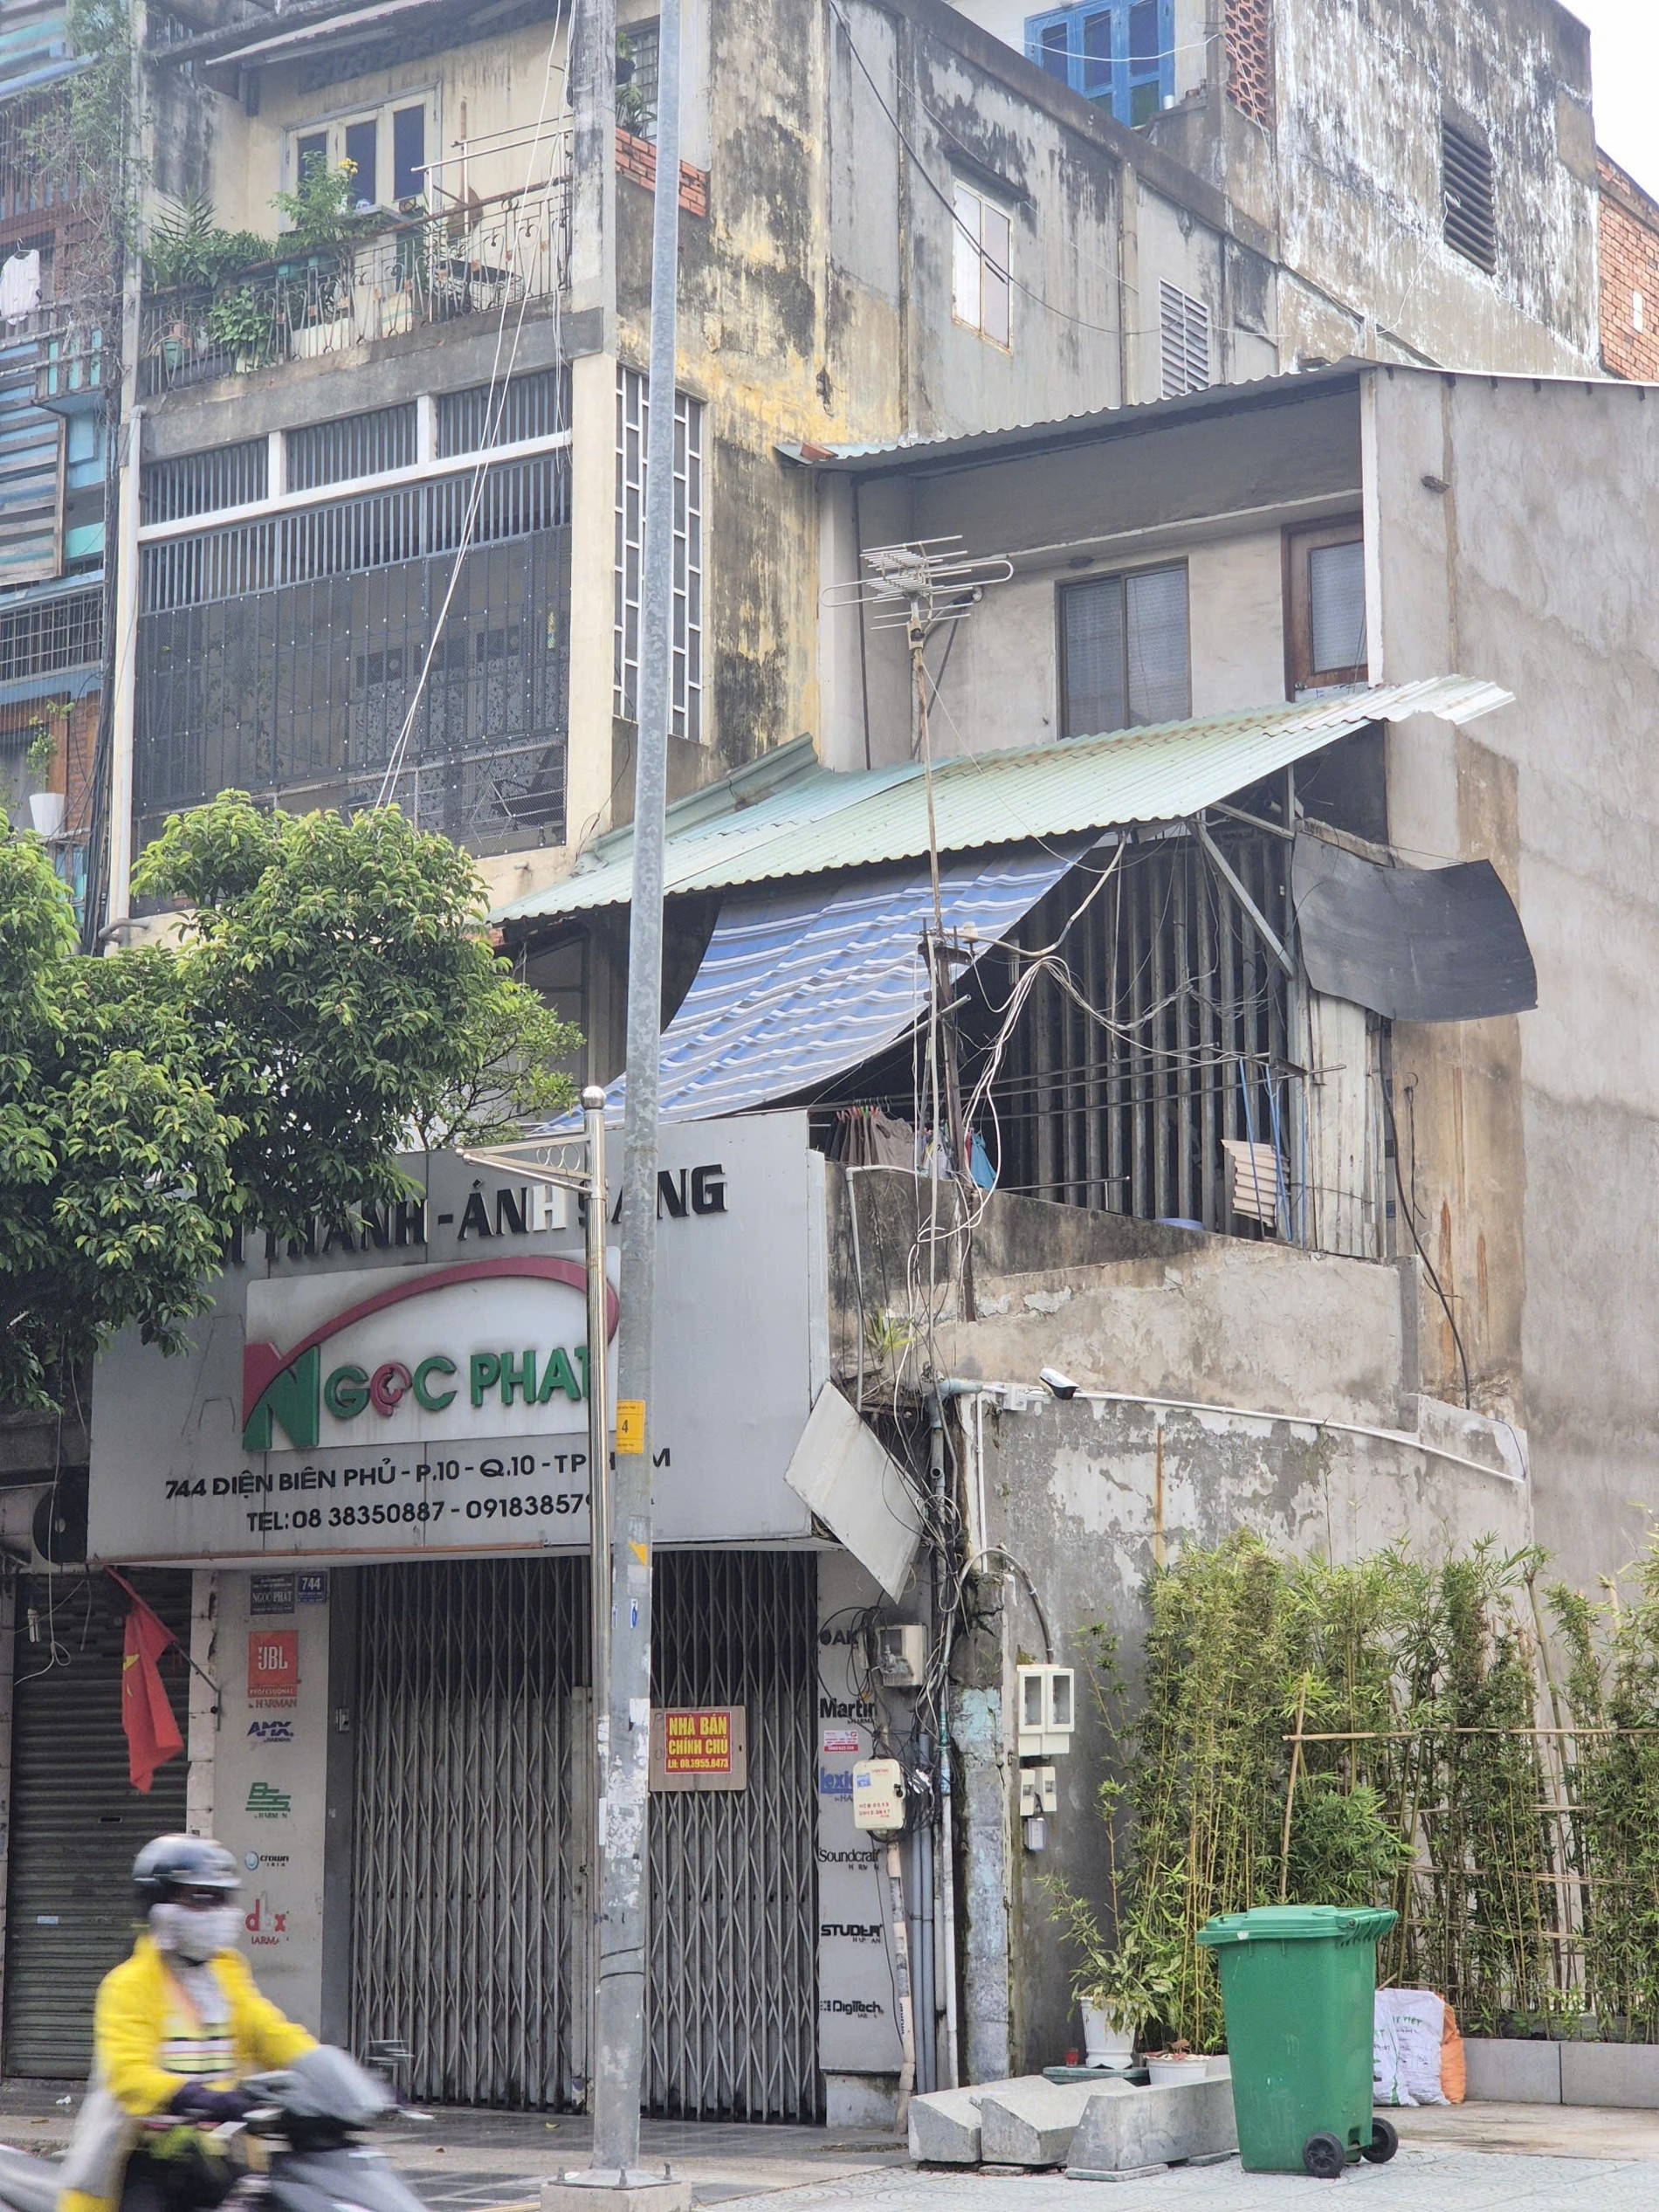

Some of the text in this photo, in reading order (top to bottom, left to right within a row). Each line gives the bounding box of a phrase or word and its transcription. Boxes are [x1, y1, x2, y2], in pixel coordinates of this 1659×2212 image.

[166, 1479, 207, 1499] 744
[279, 1466, 336, 1491] BIÊN
[344, 1457, 396, 1487] PHỦ
[416, 1459, 459, 1483] P.10
[479, 1454, 535, 1478] Q.10
[328, 1501, 445, 1527] 38350887
[301, 1576, 321, 1590] 744
[258, 1646, 288, 1670] JBL
[669, 1712, 726, 1735] NHÀ BÁN
[668, 1734, 728, 1755] CHÍNH CHỦ
